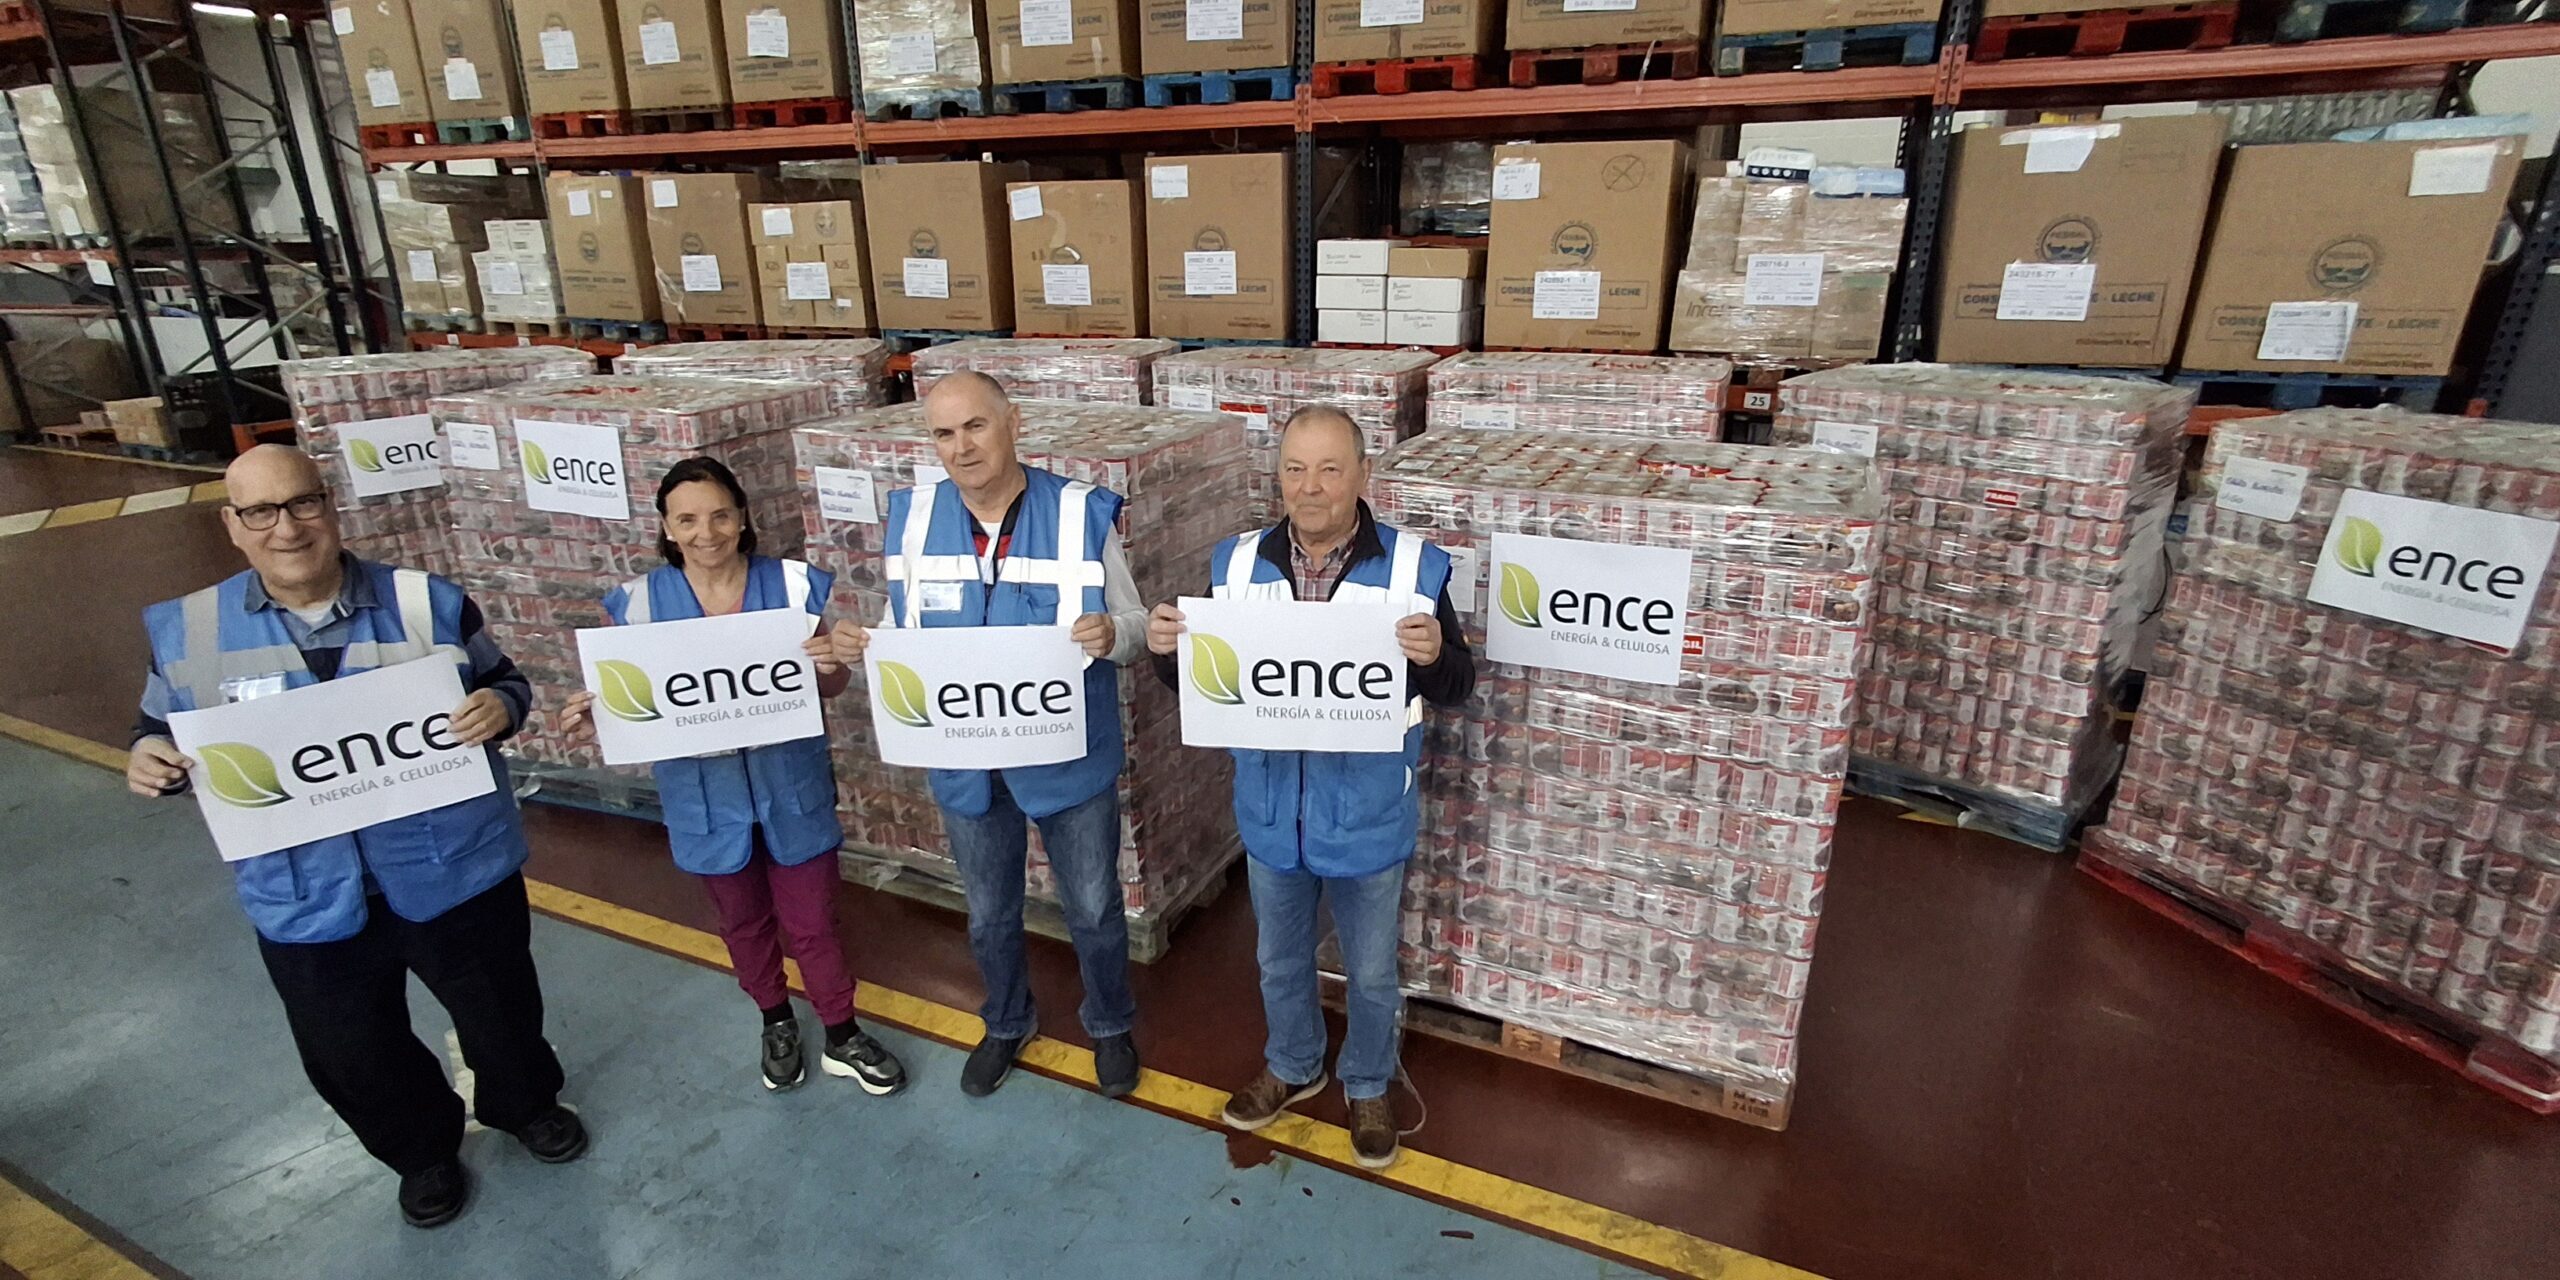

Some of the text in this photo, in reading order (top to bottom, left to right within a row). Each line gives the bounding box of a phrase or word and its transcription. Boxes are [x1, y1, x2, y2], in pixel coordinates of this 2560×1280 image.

[1750, 395, 1764, 406] 25
[553, 456, 617, 487] ence
[2388, 545, 2525, 600] ence
[1549, 588, 1674, 636] ence
[1550, 629, 1671, 655] ENERGÍA & CELULOSA
[666, 659, 802, 707] ence
[937, 679, 1072, 719] ence
[1251, 658, 1393, 700] ence
[675, 699, 808, 729] ENERGÍA & CELULOSA
[945, 722, 1075, 739] ENERGÍA & CELULOSA
[1256, 704, 1391, 721] ENERGÍA & CELULOSA
[292, 712, 462, 784] ence
[309, 755, 473, 807] ENERGÍA & CELULOSA
